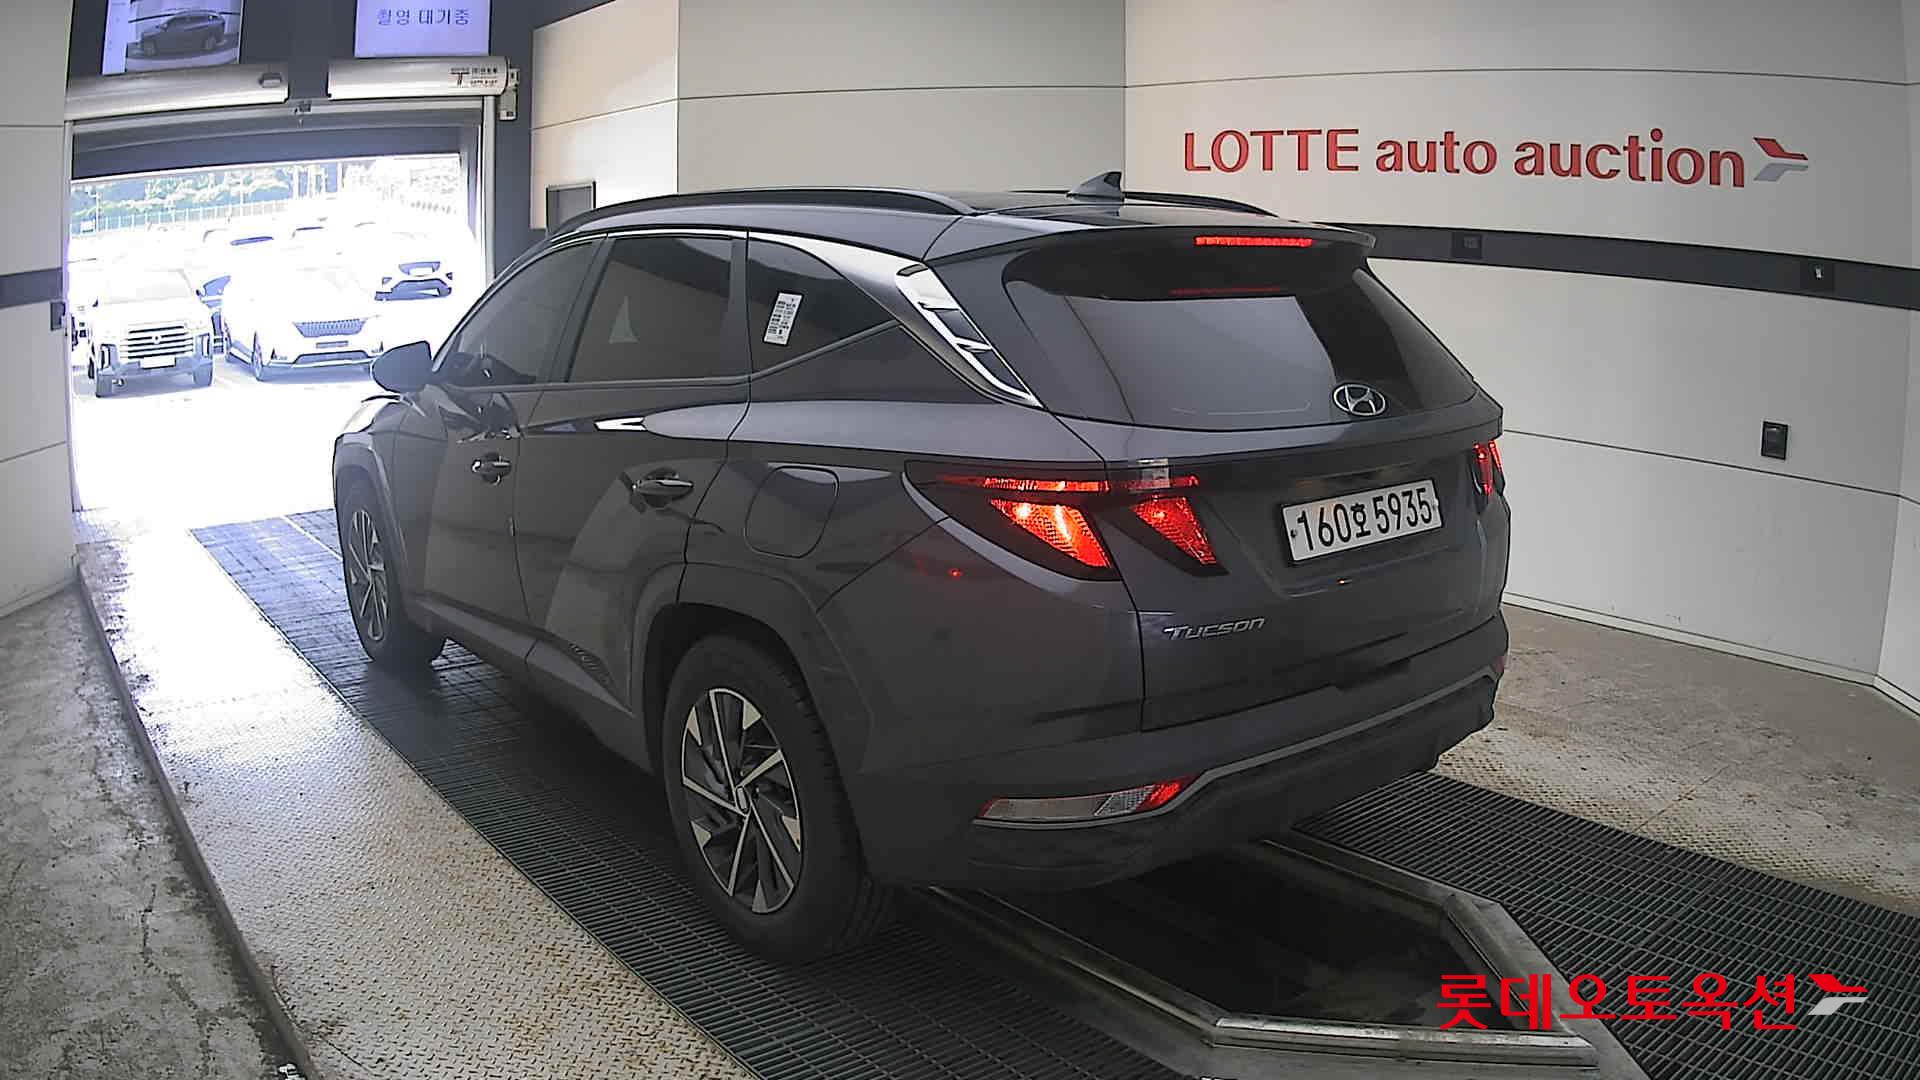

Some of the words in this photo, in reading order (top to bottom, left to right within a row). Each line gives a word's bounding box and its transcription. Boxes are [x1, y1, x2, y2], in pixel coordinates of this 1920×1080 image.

[418, 8, 469, 26] 대기중
[1184, 129, 1360, 173] LOTTE
[1375, 131, 1497, 174] auto
[1514, 127, 1745, 188] auction
[1297, 503, 1371, 550] 160호
[1373, 488, 1432, 533] 5935
